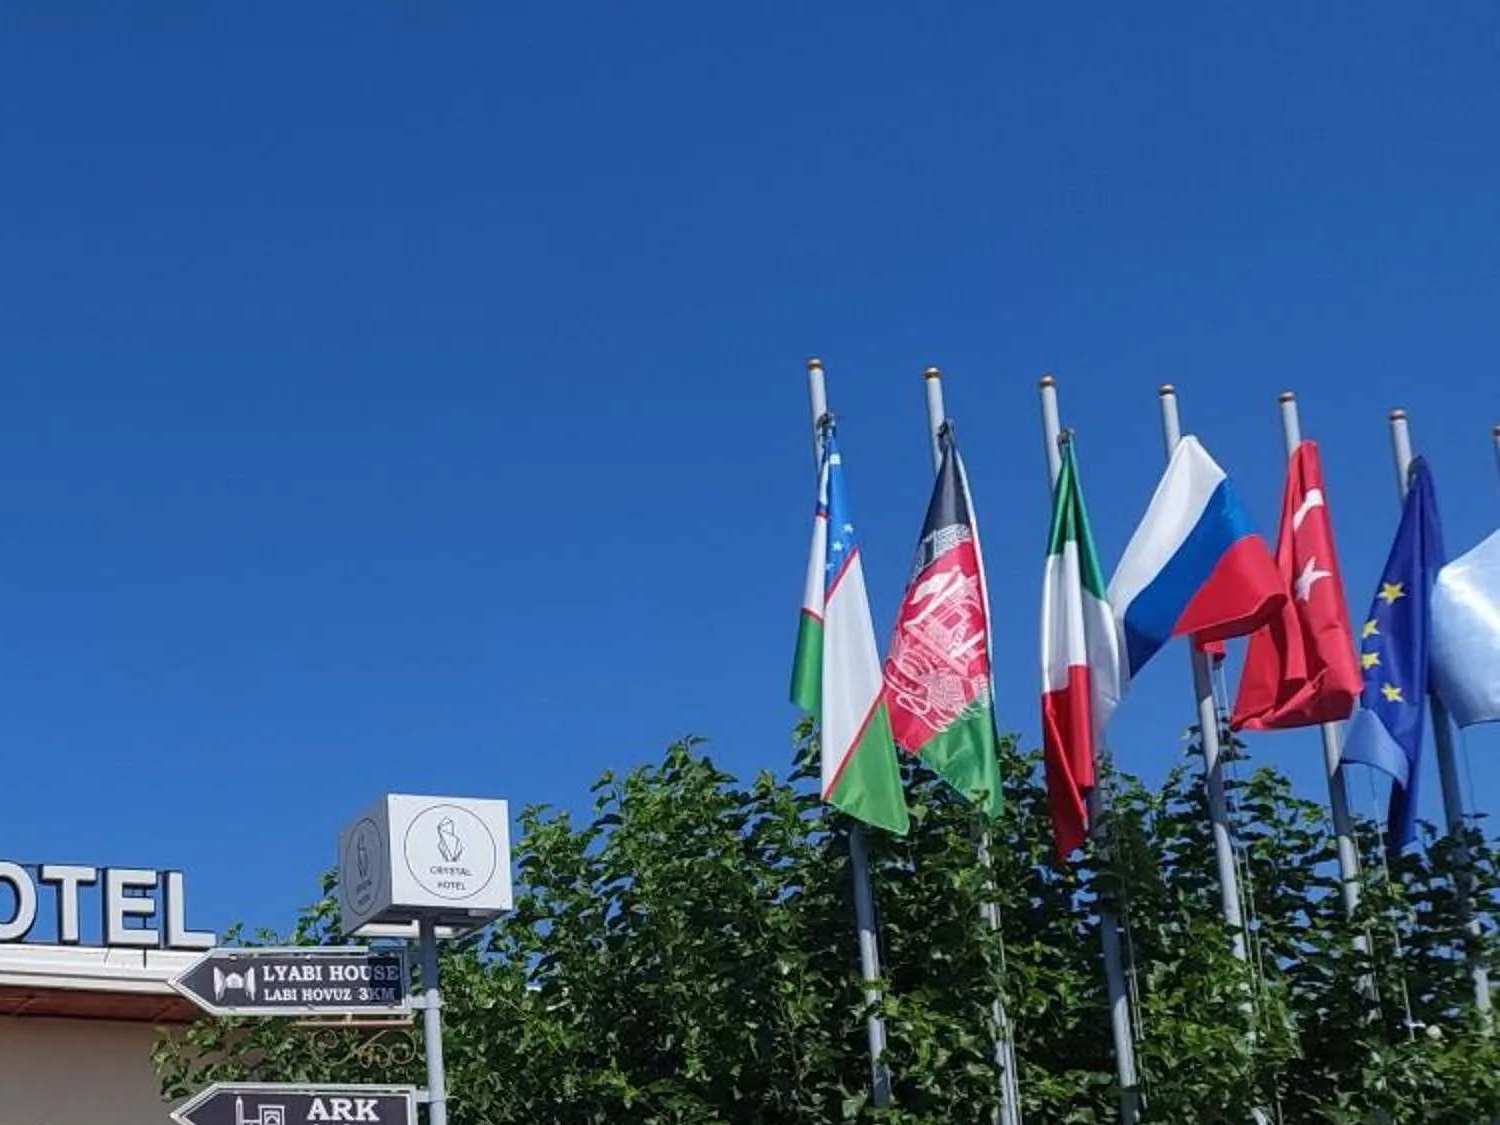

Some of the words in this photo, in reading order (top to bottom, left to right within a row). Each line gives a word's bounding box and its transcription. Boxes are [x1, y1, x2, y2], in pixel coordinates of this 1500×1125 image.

[429, 865, 472, 877] CRYSTAL
[437, 881, 466, 891] HOTEL
[262, 965, 323, 982] LYABI
[328, 965, 399, 982] HOUSE
[263, 988, 297, 1001] LABI
[302, 988, 352, 1001] HOVUZ
[306, 1098, 380, 1121] ARK
